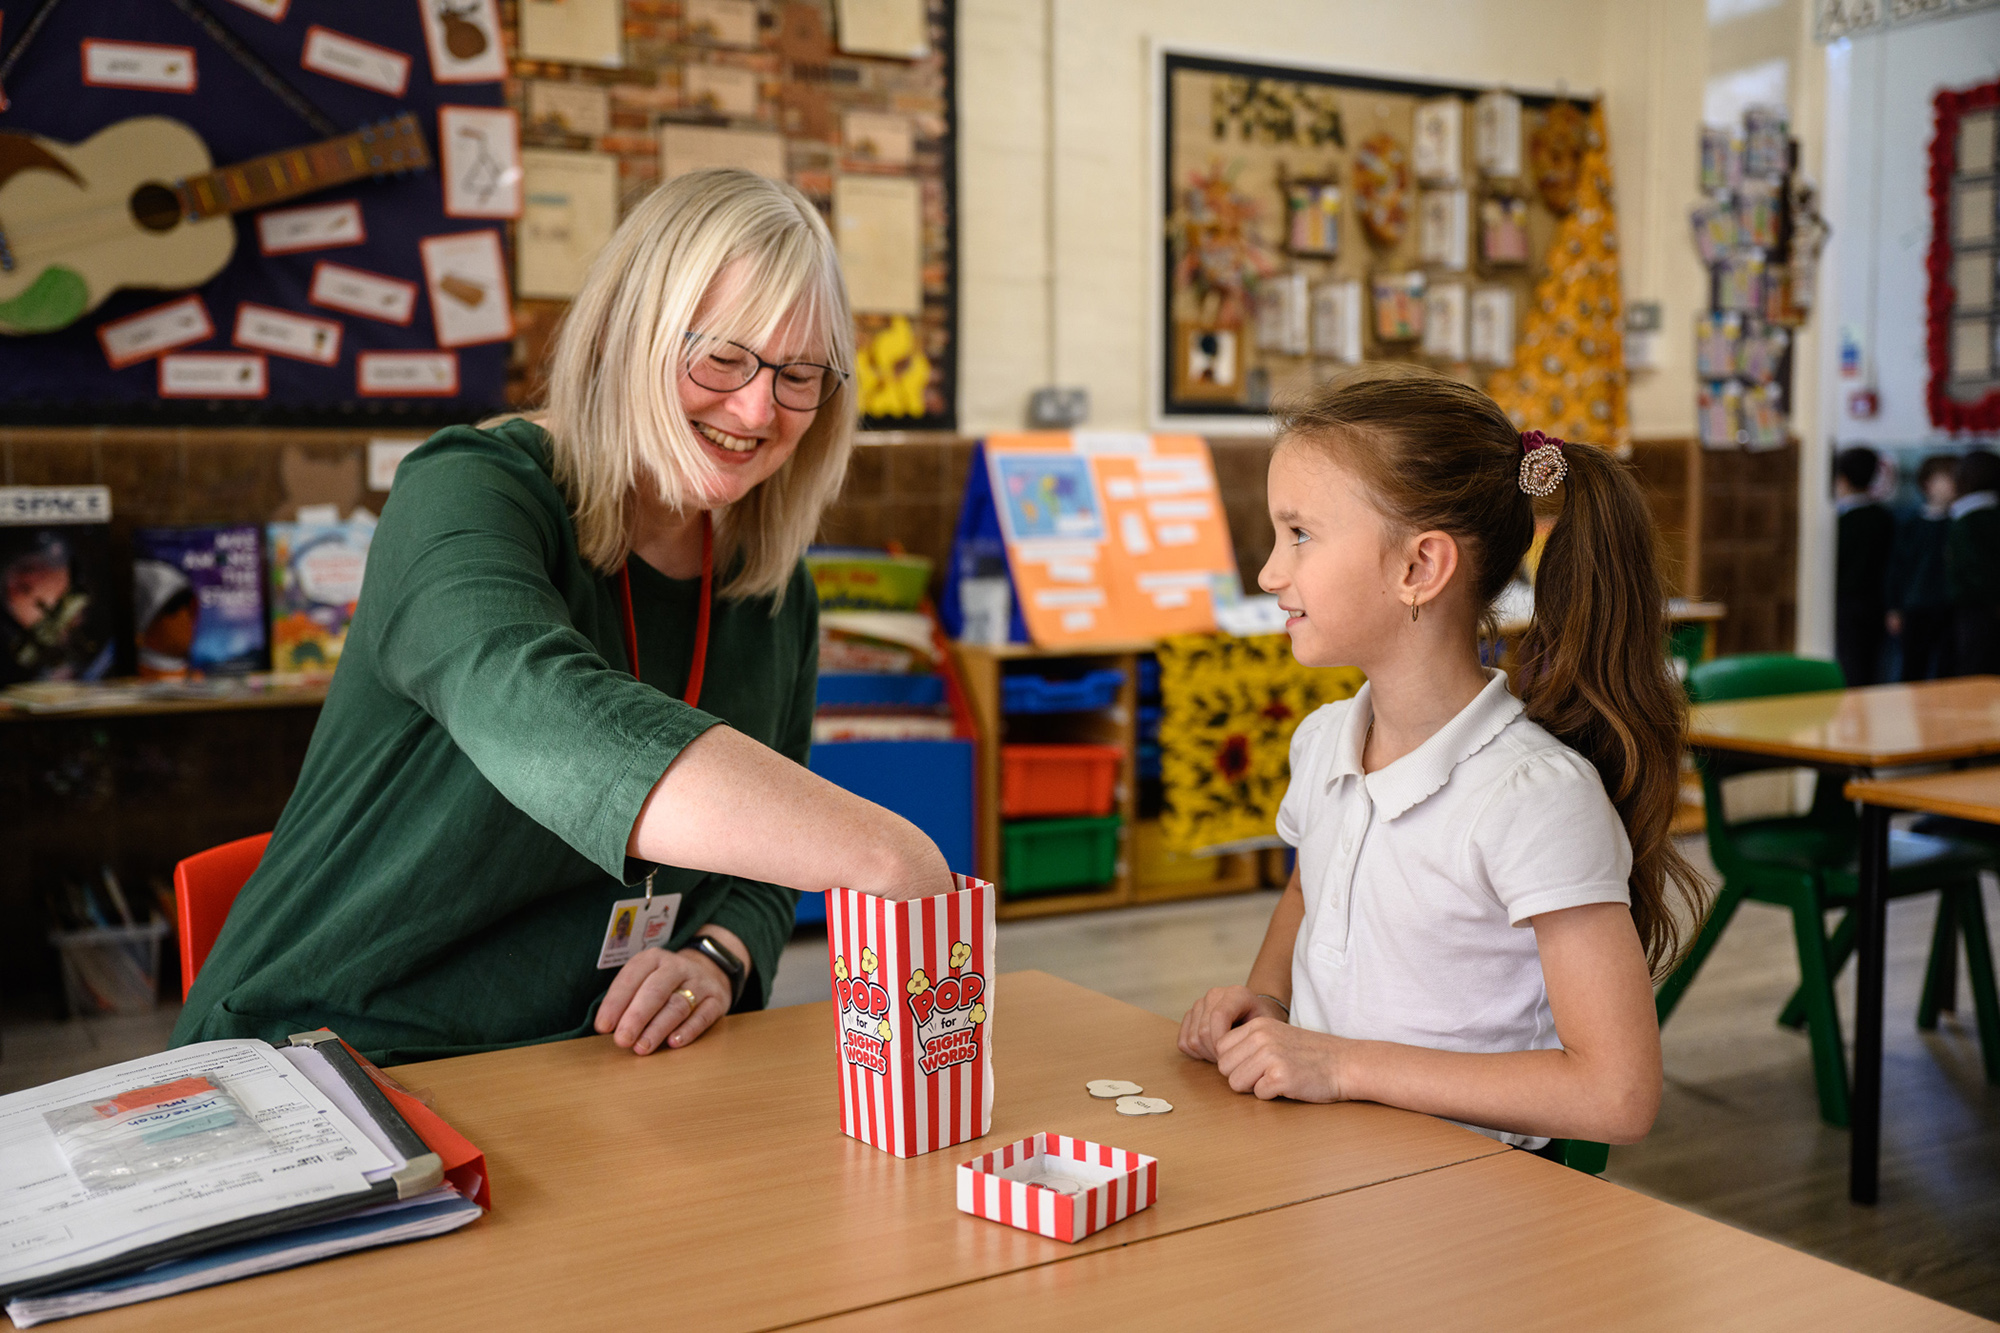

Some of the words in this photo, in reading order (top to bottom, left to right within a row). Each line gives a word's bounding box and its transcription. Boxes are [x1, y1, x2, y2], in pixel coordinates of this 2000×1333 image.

[837, 978, 889, 1018] POP
[909, 974, 984, 1024] POP
[856, 1015, 868, 1029] for
[941, 1017, 957, 1029] for
[847, 1031, 881, 1055] SIGHT
[926, 1030, 972, 1055] SIGHT
[845, 1046, 885, 1073] WORDS
[921, 1044, 976, 1072] WORDS
